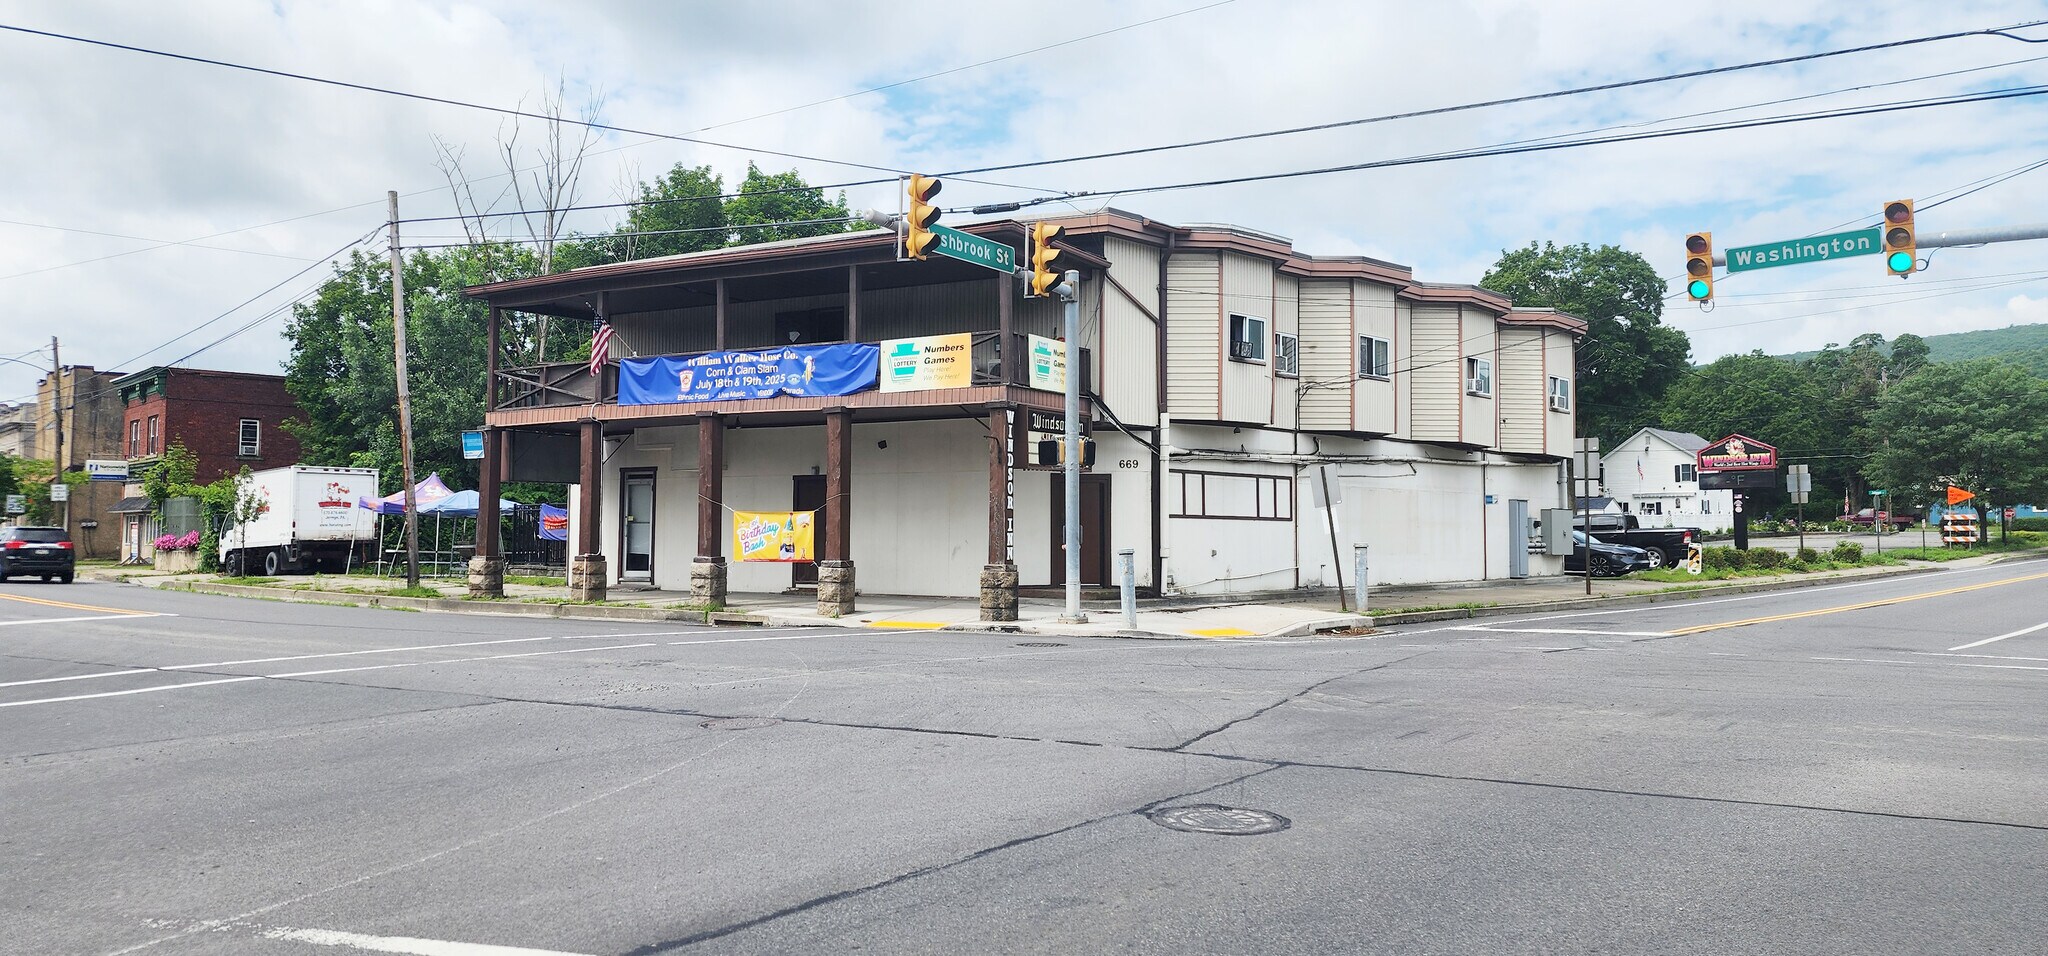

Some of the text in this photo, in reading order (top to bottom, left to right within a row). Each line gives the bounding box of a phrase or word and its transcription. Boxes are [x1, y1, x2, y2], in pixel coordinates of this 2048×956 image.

[940, 233, 1010, 266] shbrook St
[1735, 237, 1870, 266] Washington
[924, 344, 965, 354] Numbers
[687, 350, 799, 367] William Walker Hose Co.
[923, 356, 955, 365] Games
[706, 363, 779, 378] Corn & Clam Slam
[695, 373, 786, 391] July 18th & 19th, 2025
[677, 393, 694, 401] Ethnic
[694, 392, 710, 400] Food
[717, 390, 729, 399] Live
[729, 390, 746, 398] Music
[1032, 412, 1066, 432] Windso
[1119, 459, 1139, 469] 669
[1701, 452, 1771, 468] WINDSOR INN
[1006, 410, 1015, 561] WINDSOR INN
[740, 521, 780, 541] Birthday
[743, 537, 766, 553] Bash
